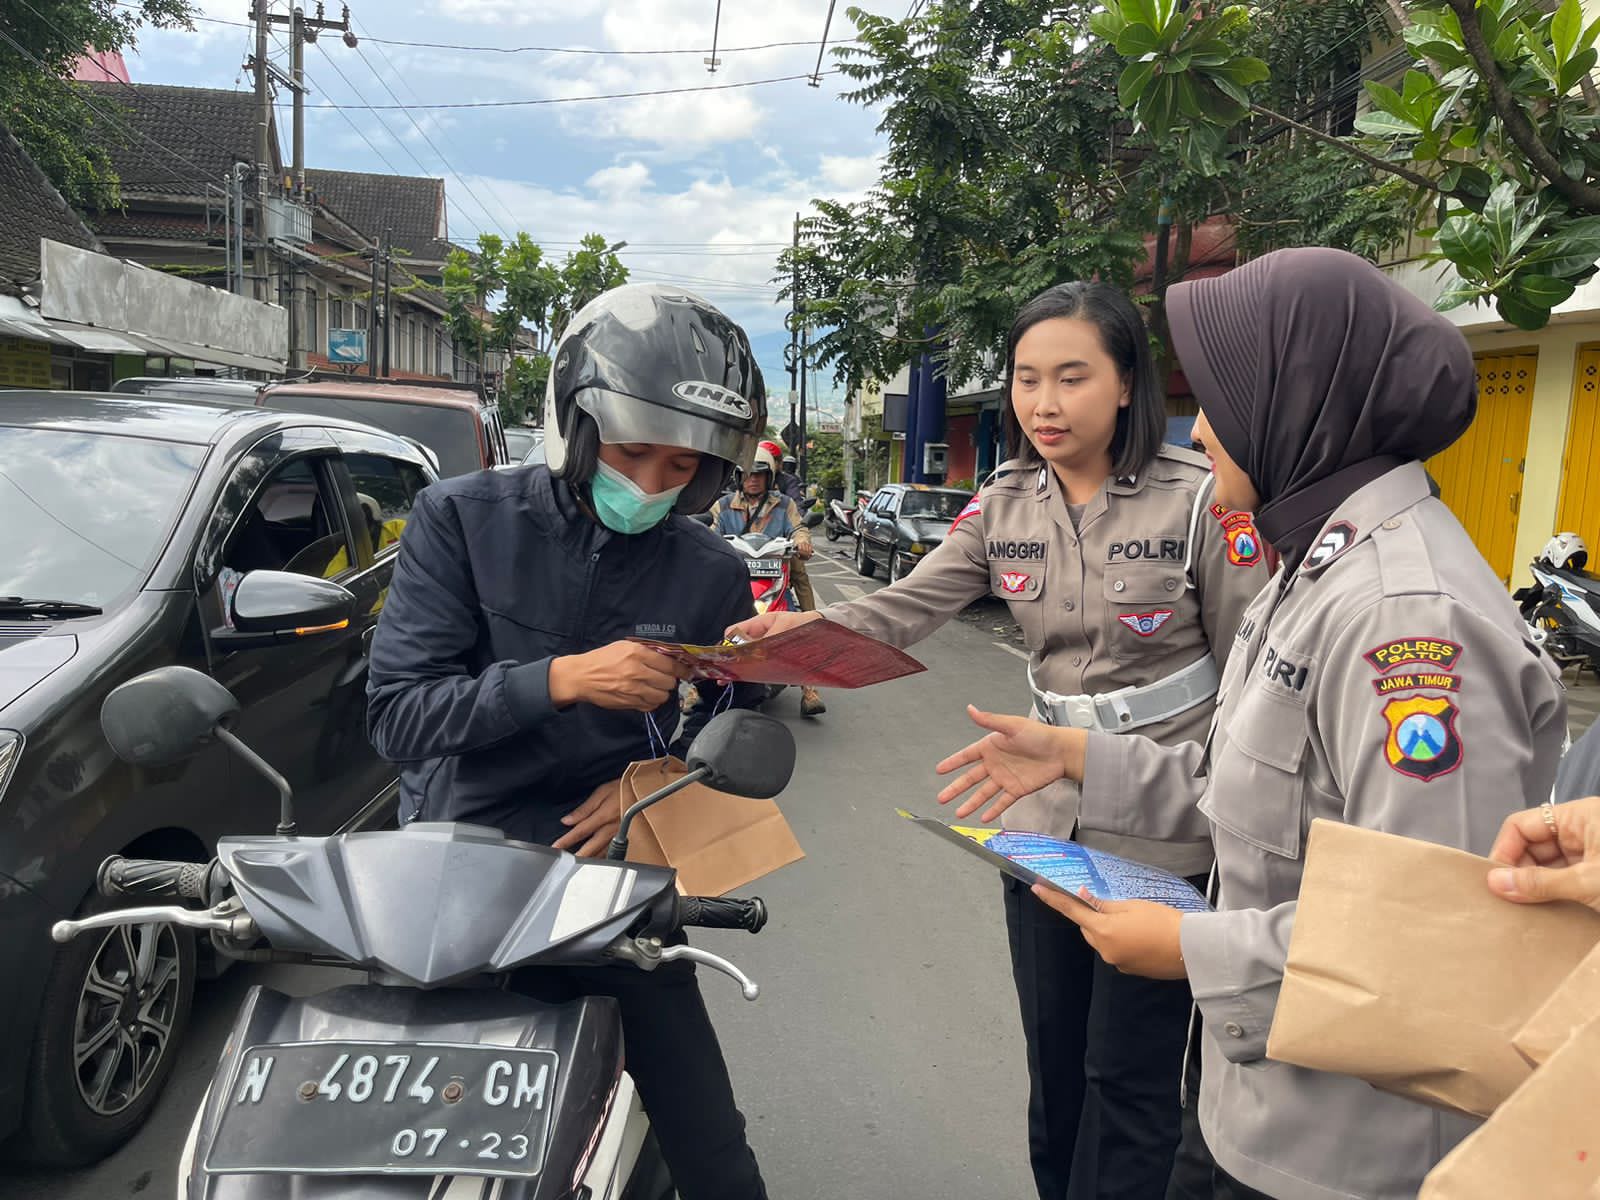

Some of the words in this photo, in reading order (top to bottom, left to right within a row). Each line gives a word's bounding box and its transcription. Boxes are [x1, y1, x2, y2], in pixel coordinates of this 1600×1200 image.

[684, 384, 747, 412] INK
[987, 540, 1046, 560] ANGGRI
[1107, 539, 1185, 561] POLRI
[1375, 641, 1454, 661] POLRES
[1388, 652, 1442, 664] BATU
[1380, 677, 1414, 691] JAWA
[1417, 674, 1454, 689] TIMUR
[236, 1056, 275, 1104] N
[317, 1053, 441, 1105] 4874
[482, 1059, 549, 1110] GM
